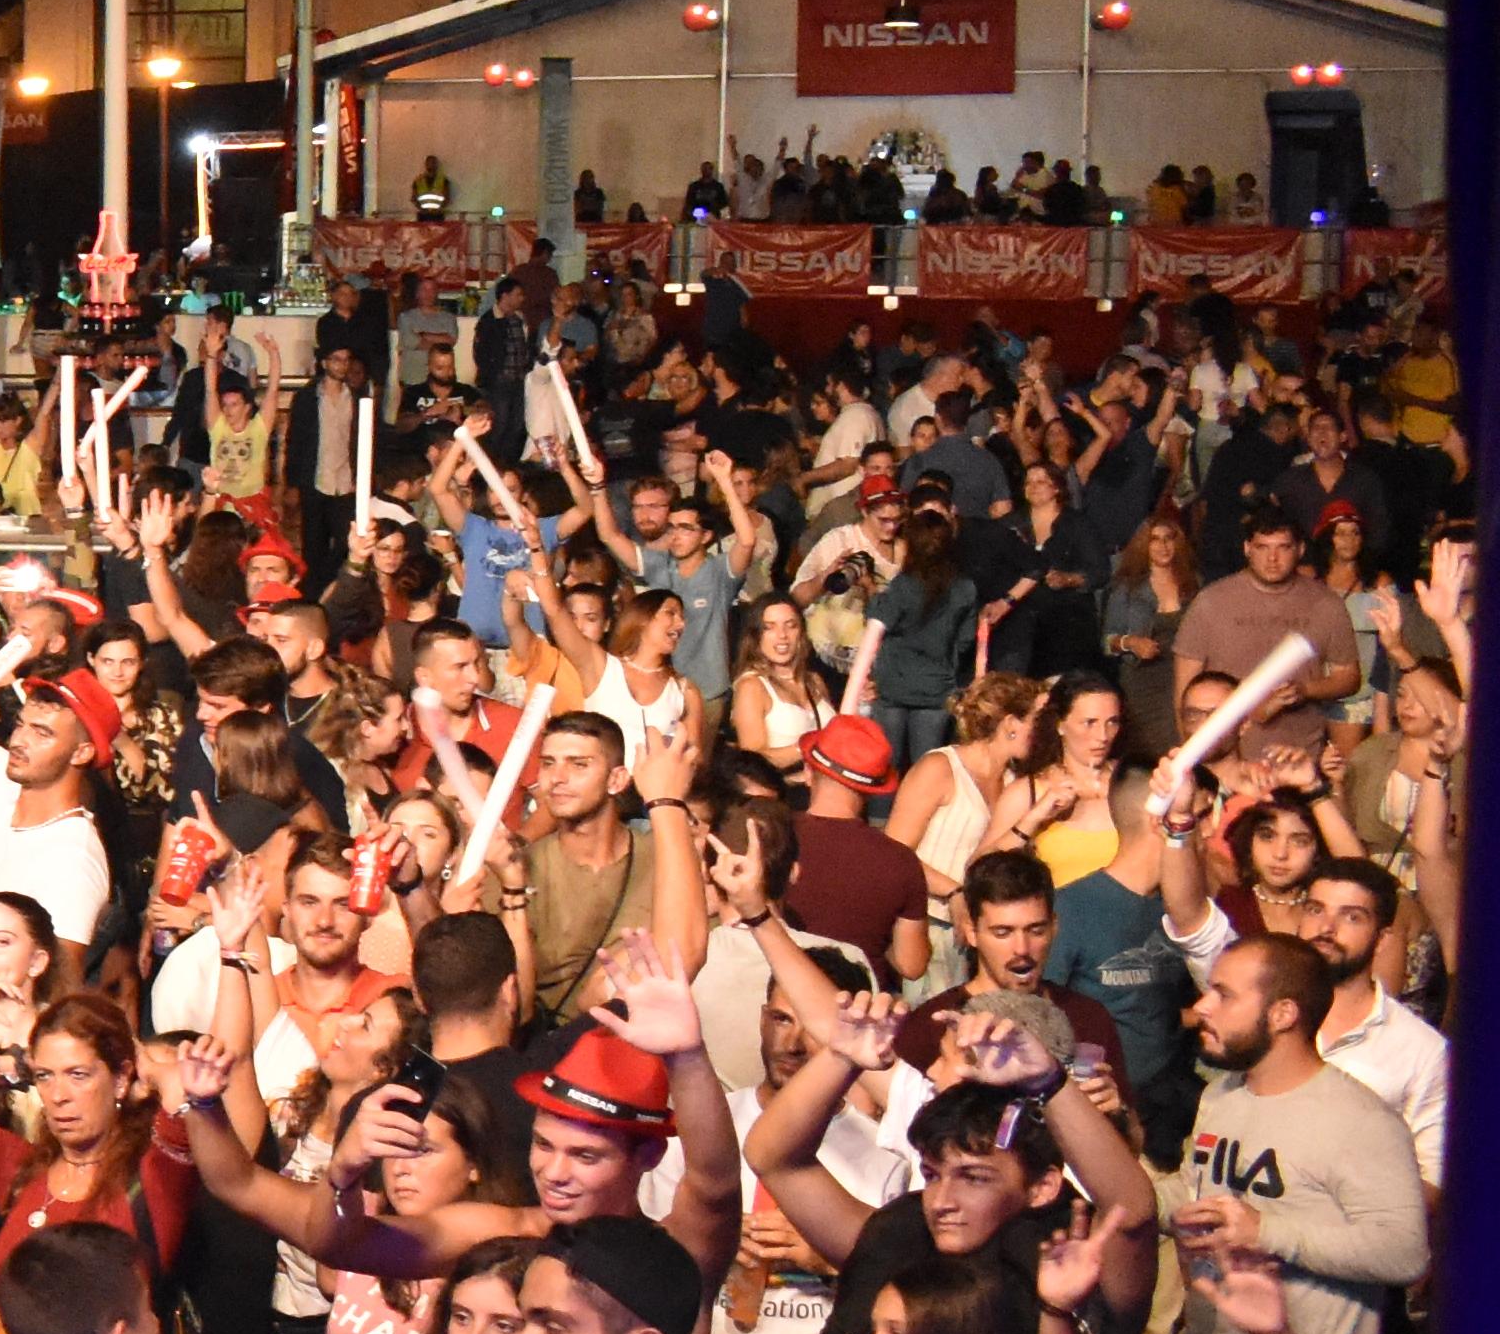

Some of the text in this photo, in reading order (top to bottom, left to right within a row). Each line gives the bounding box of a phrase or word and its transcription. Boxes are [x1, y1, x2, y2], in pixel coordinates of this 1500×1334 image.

[823, 22, 989, 47] NISSAN
[927, 251, 1079, 273] NISSAN
[1139, 252, 1297, 277] NISSAN
[567, 1088, 617, 1114] NISSAN
[1193, 1133, 1286, 1199] FILA
